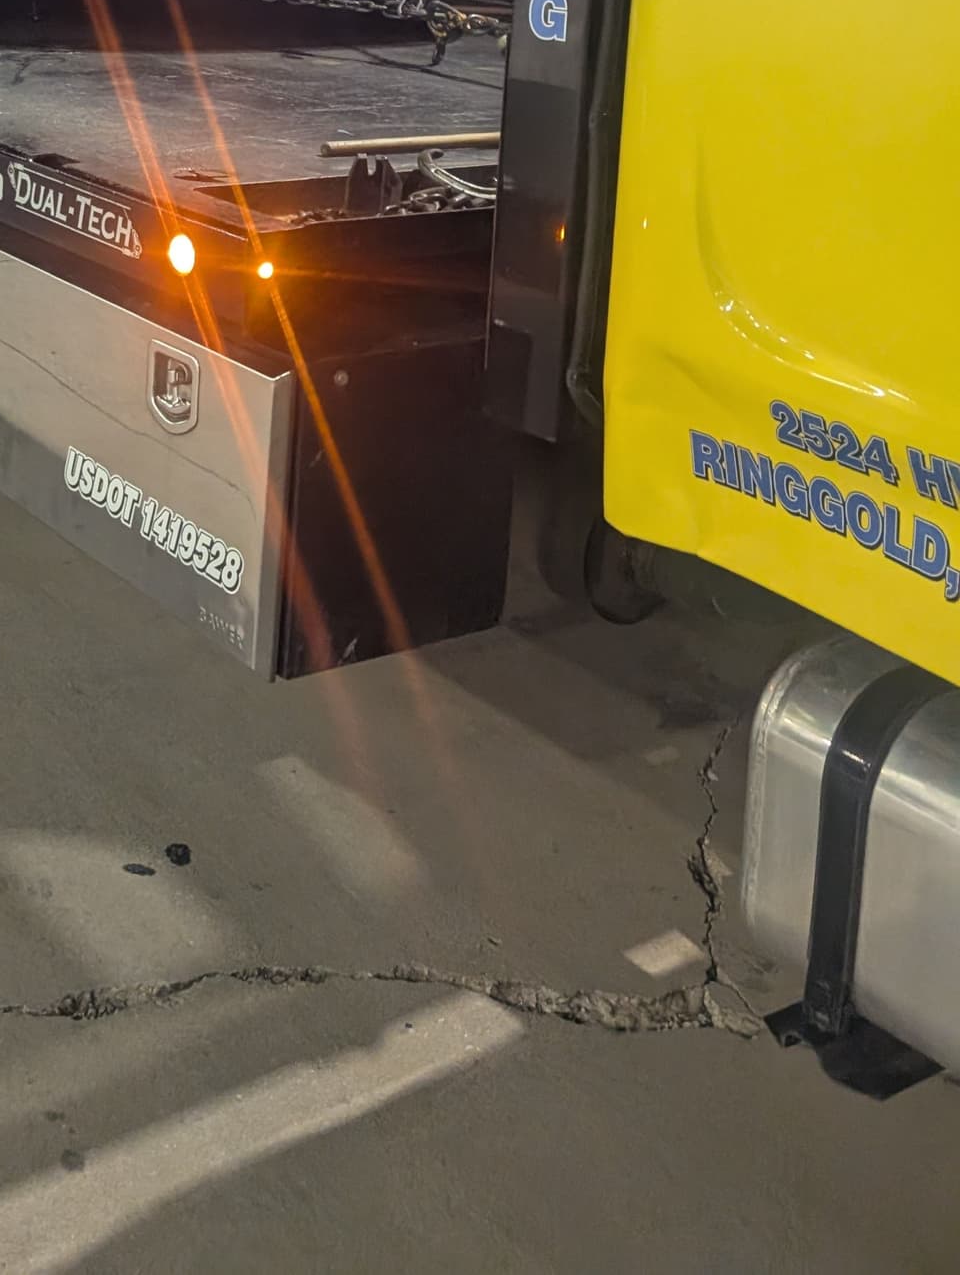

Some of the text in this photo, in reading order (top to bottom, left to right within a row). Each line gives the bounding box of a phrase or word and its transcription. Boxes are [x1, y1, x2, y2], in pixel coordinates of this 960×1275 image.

[14, 171, 132, 248] DUAL-TECH
[769, 399, 899, 487] 2524
[64, 445, 245, 594] USDOT 1419528
[689, 429, 960, 602] RINGGOLD,
